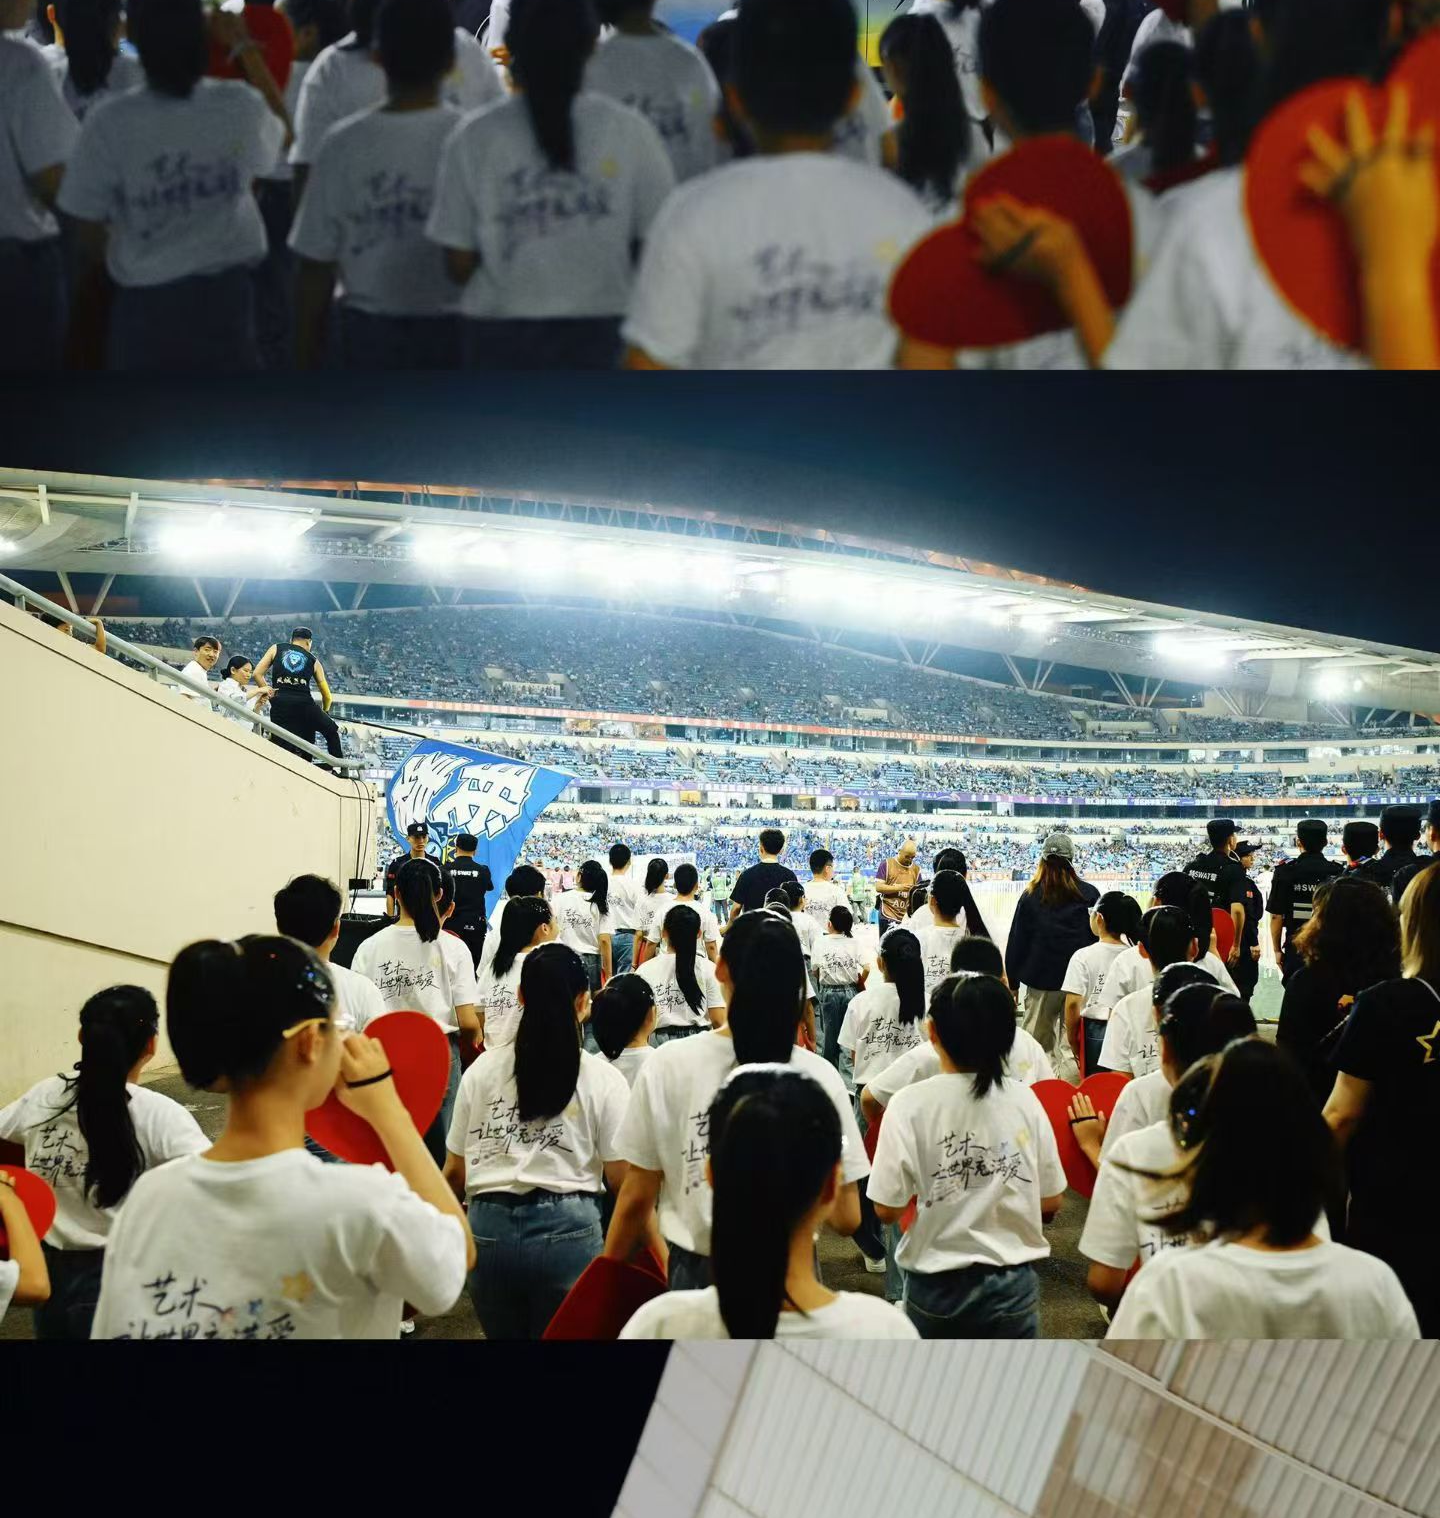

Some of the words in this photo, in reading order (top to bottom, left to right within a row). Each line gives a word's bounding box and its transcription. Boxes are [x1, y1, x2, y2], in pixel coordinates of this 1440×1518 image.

[40, 1124, 82, 1153] 艺术
[470, 1123, 573, 1154] 让世界充满爱
[937, 1131, 990, 1157] 艺术
[142, 1270, 233, 1318] 艺术
